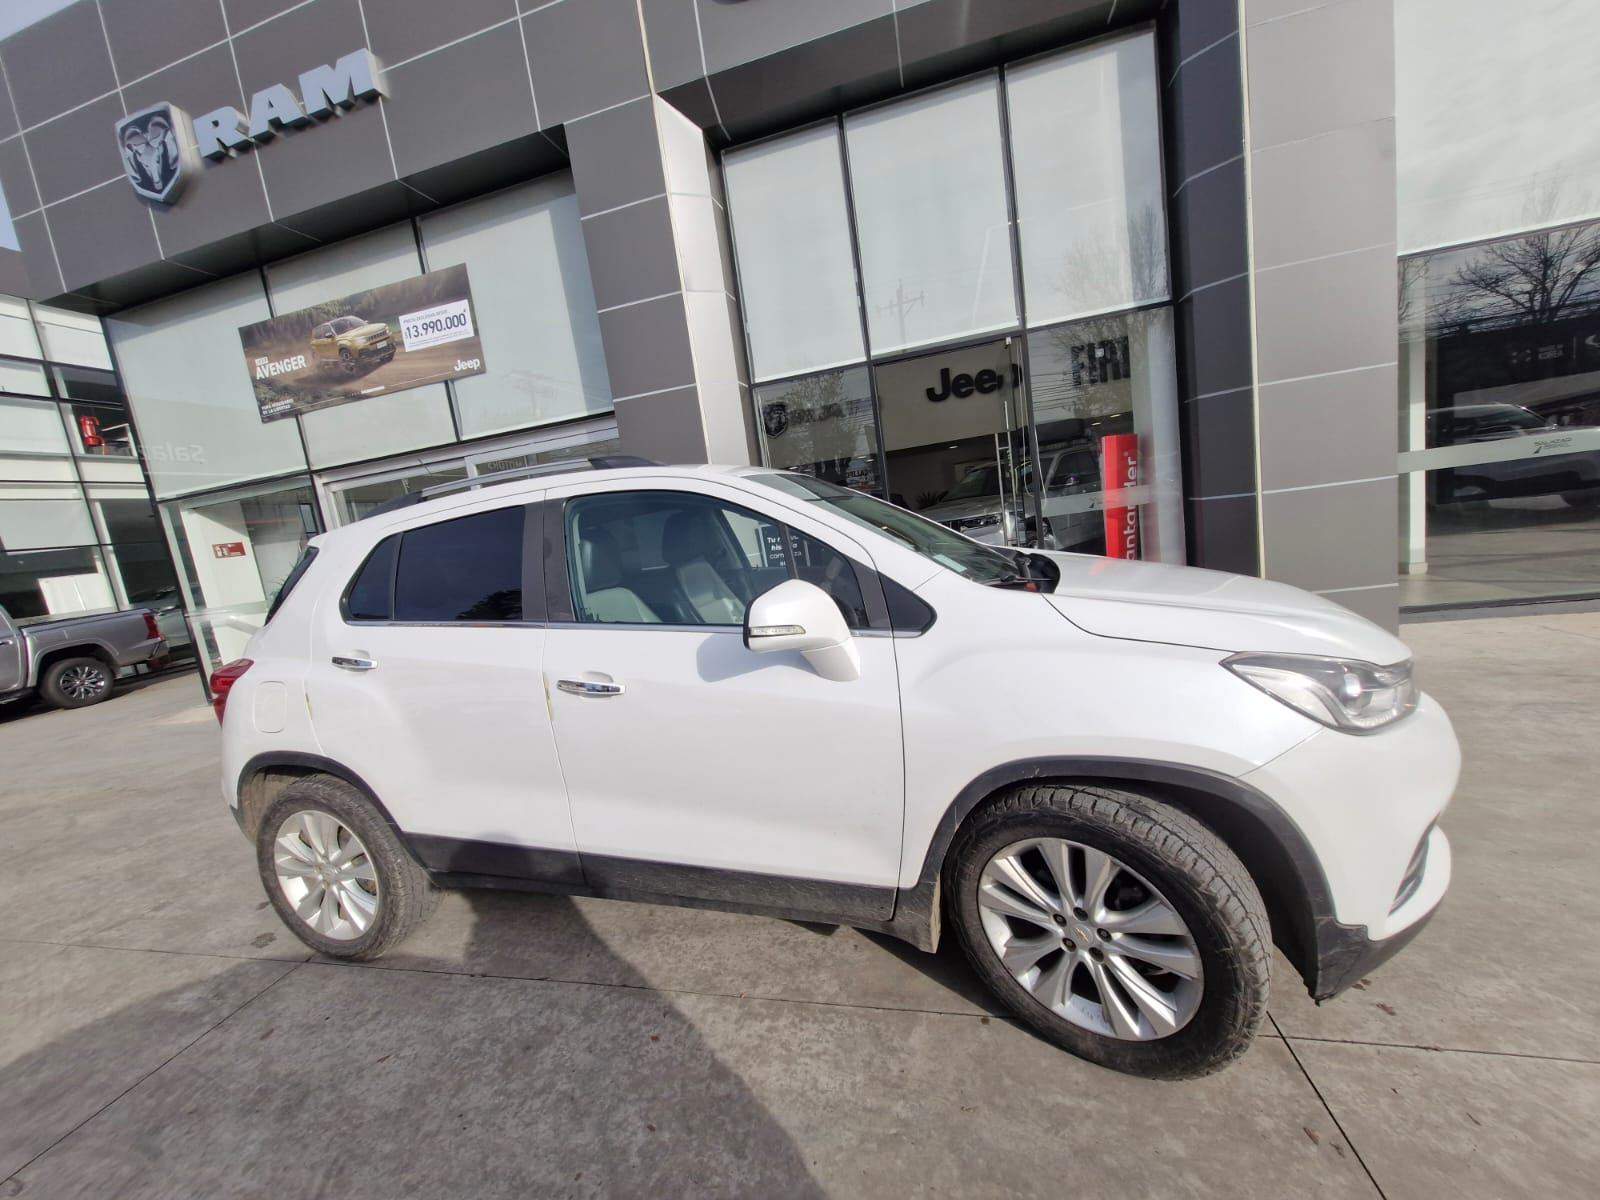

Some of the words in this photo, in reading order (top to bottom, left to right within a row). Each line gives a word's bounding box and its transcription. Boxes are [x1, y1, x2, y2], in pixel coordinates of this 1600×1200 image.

[193, 48, 384, 160] RAM
[256, 355, 307, 380] AVENGER
[454, 358, 480, 371] Jeep
[1123, 456, 1137, 560] antaer
